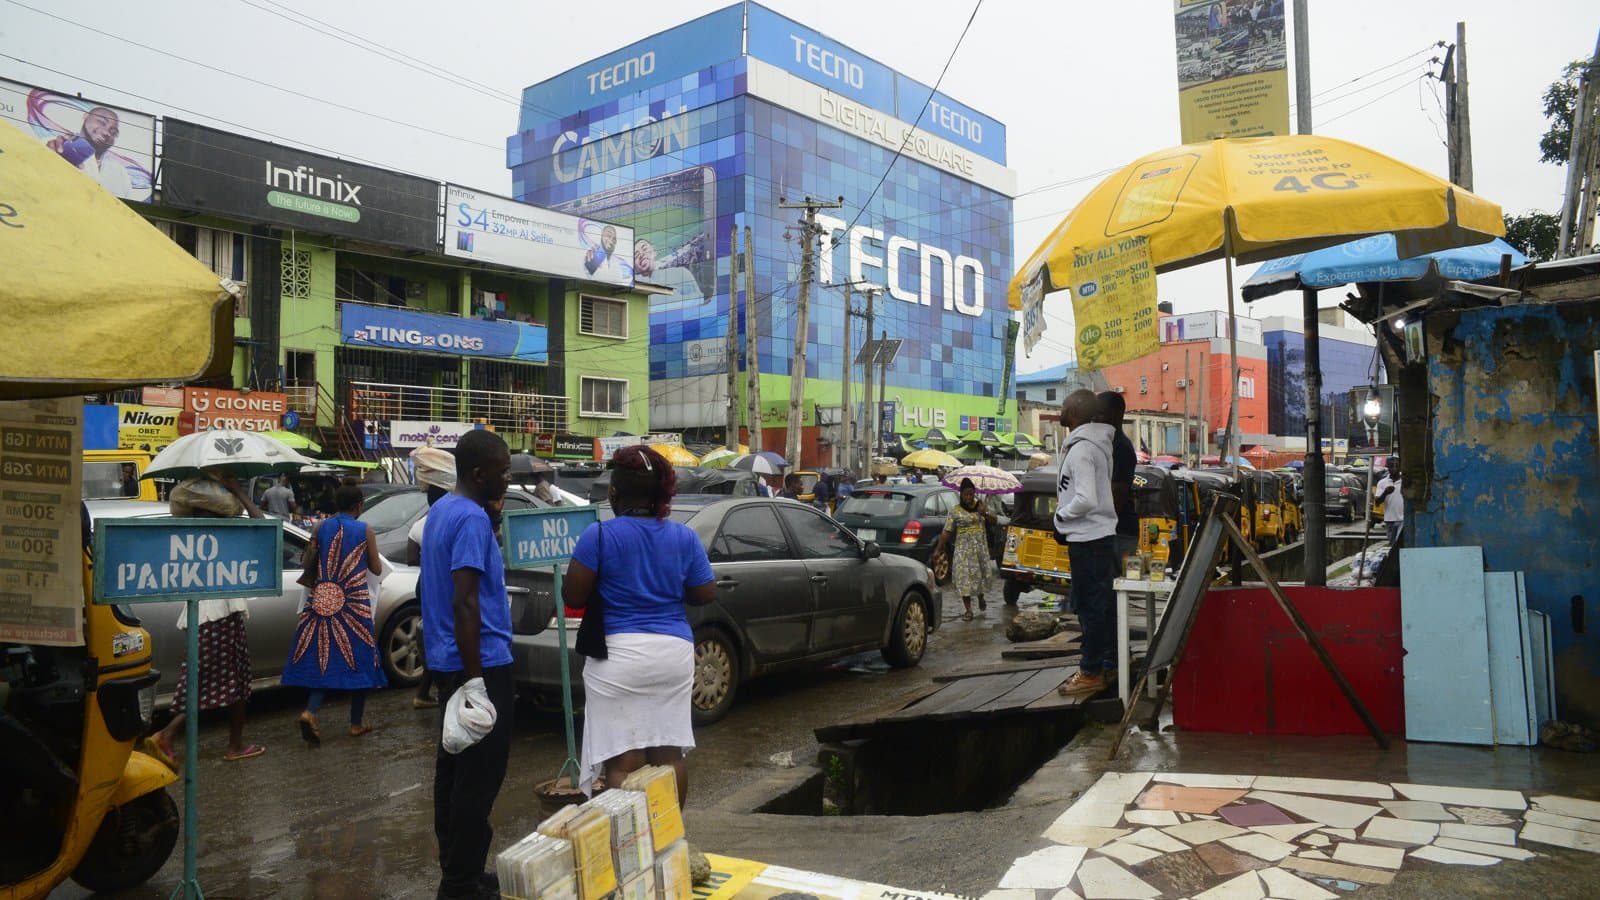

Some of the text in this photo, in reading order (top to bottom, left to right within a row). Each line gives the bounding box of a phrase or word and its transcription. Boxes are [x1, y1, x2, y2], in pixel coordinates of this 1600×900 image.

[586, 51, 656, 96] TECNO
[790, 33, 864, 91] TECNO
[929, 100, 983, 145] TECNO
[551, 104, 691, 184] CAMON
[817, 92, 975, 178] DIGITAL SQUARE
[1247, 148, 1325, 160] Upgrade
[1254, 156, 1330, 169] your SIM
[1269, 164, 1329, 175] Device
[265, 160, 362, 206] Infinix
[448, 187, 476, 201] Infinix
[1272, 172, 1361, 193] 4G
[276, 194, 293, 207] The
[457, 201, 490, 232] S4
[491, 208, 530, 227] Empower
[804, 209, 985, 317] TECNO
[1096, 247, 1116, 262] ALL
[1104, 317, 1122, 330] 100
[1133, 306, 1152, 321] 200
[215, 396, 283, 412] GIONEE
[123, 411, 176, 426] Nikon
[903, 406, 947, 429] HUB
[556, 441, 581, 449] Infinix
[543, 517, 569, 538] NO
[169, 533, 219, 562] NO
[517, 535, 580, 560] PARKIN
[117, 559, 259, 592] PARKING
